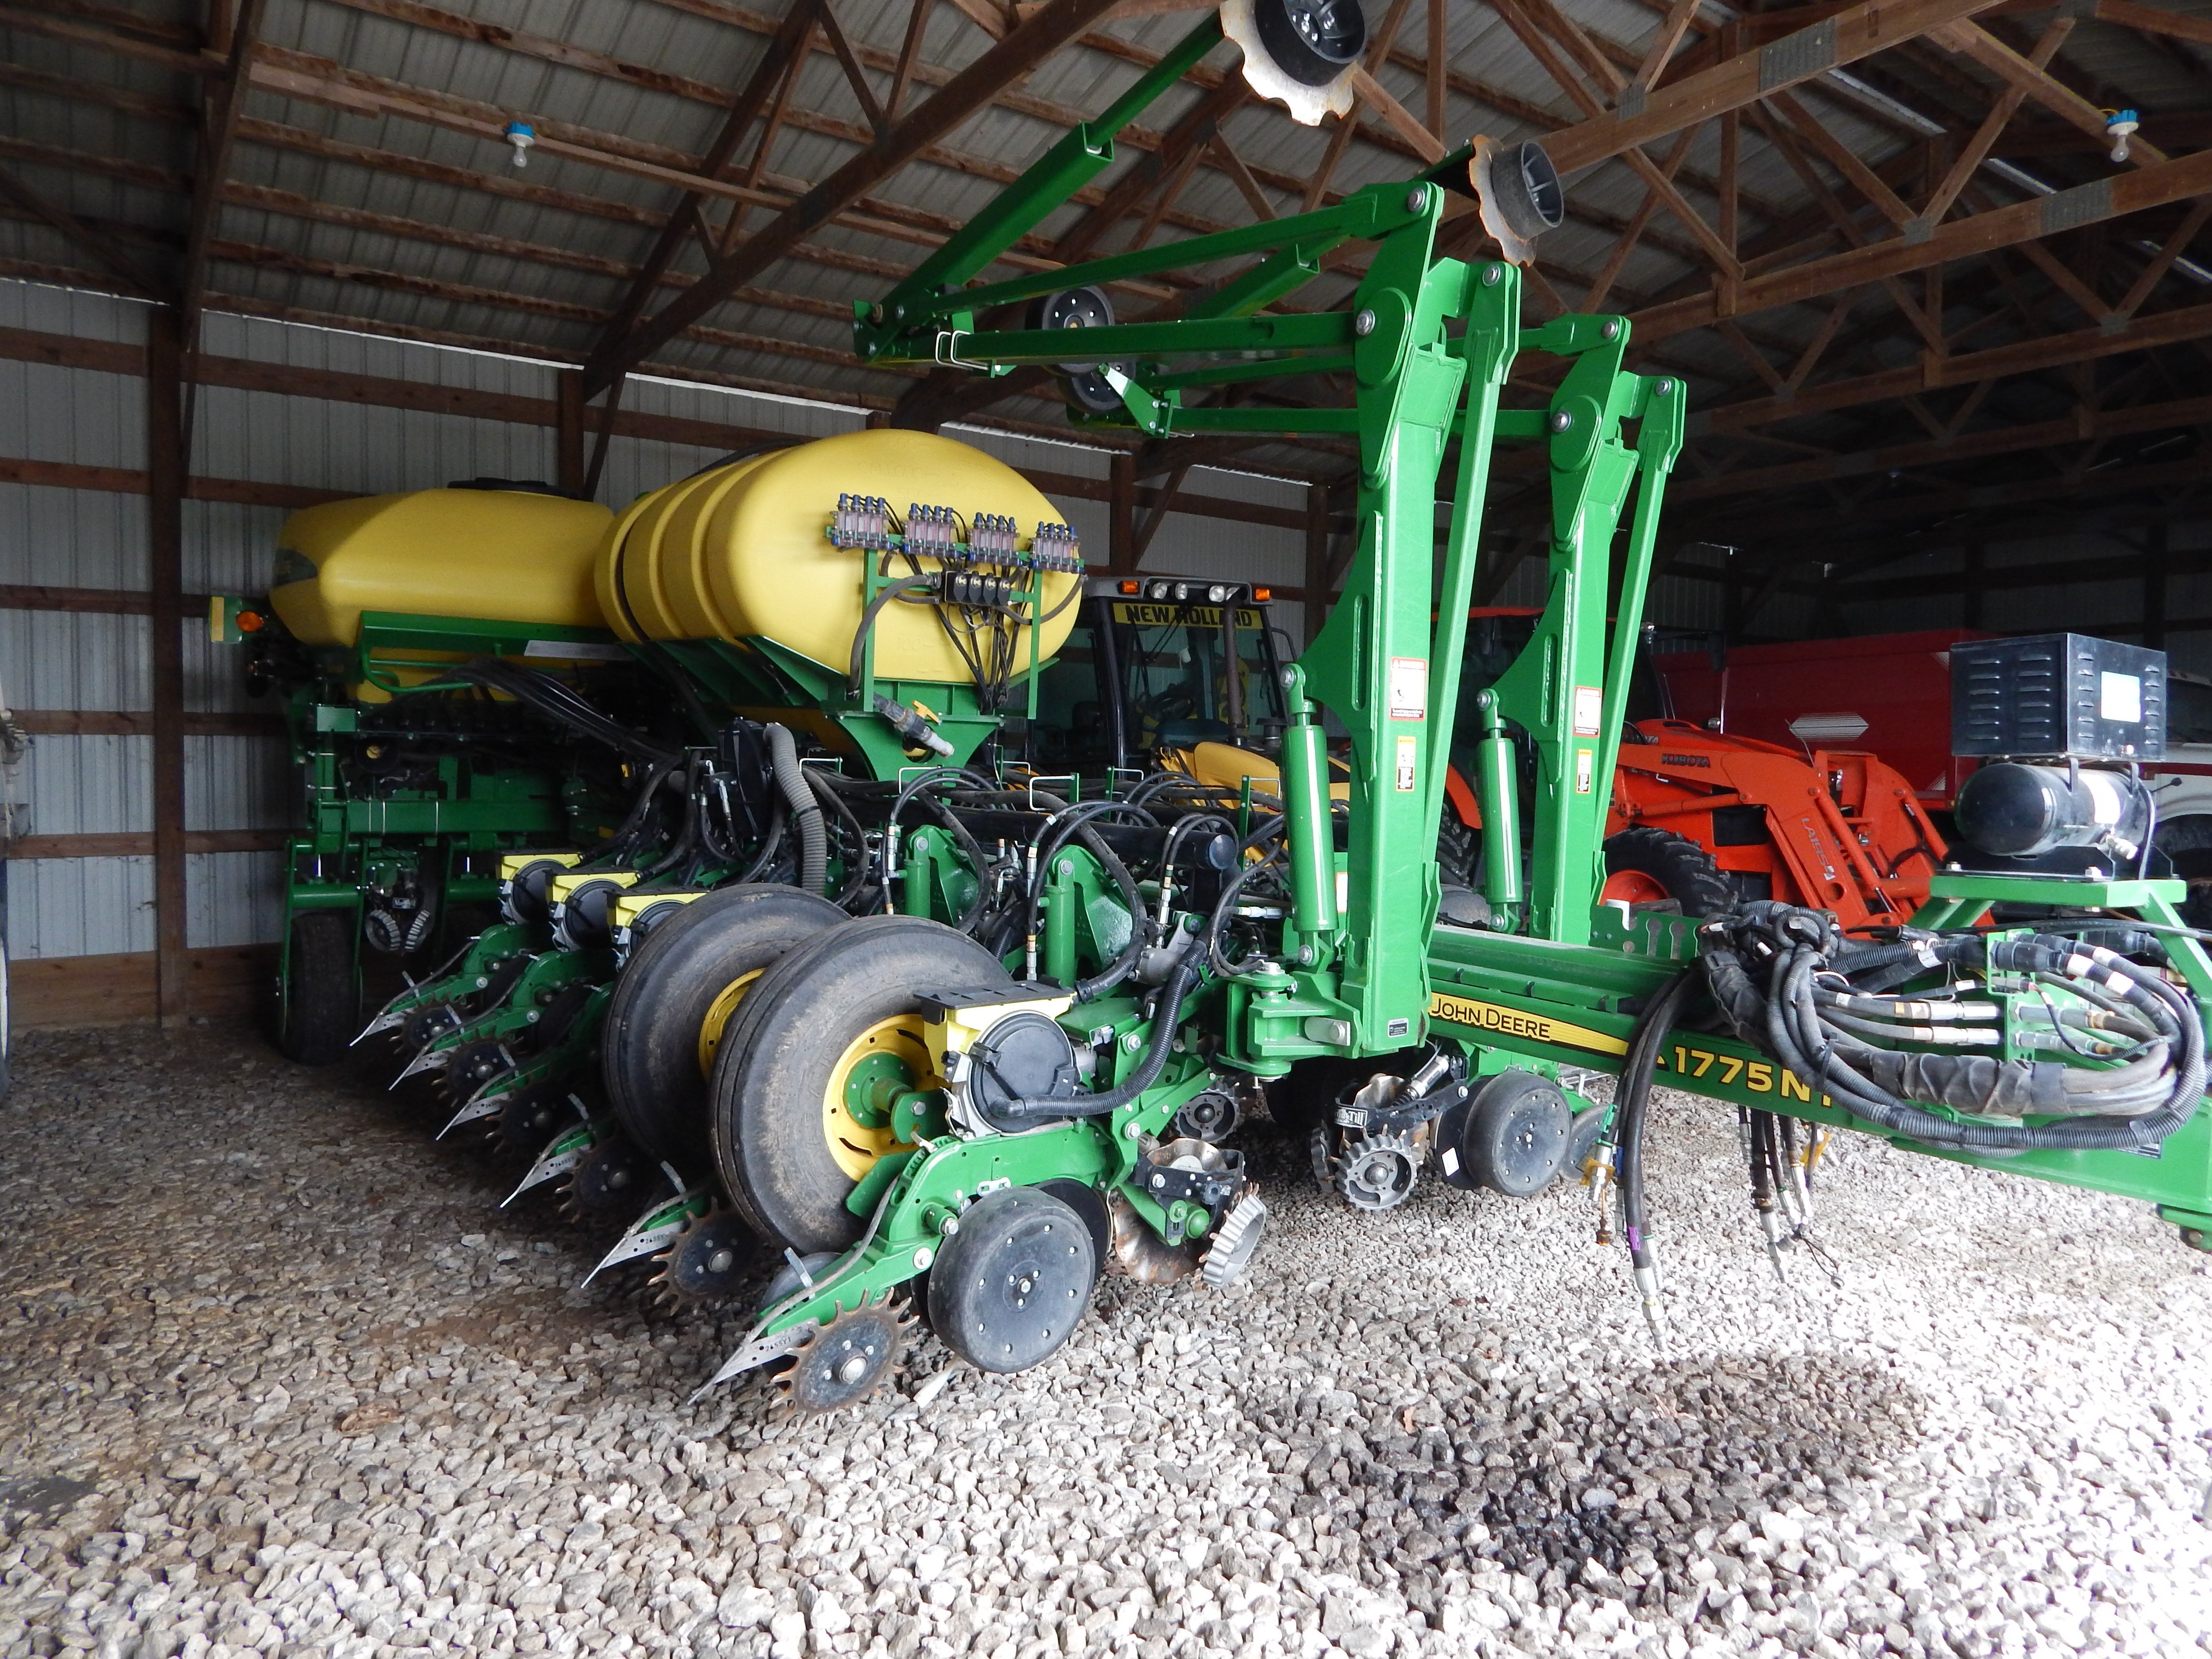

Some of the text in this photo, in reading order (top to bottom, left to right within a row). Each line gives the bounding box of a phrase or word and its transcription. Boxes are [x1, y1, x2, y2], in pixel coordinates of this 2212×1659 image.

[1125, 605, 1169, 623] NEW
[1661, 754, 1710, 768] KUBOTA
[1431, 998, 1551, 1038] JOHN DEERE
